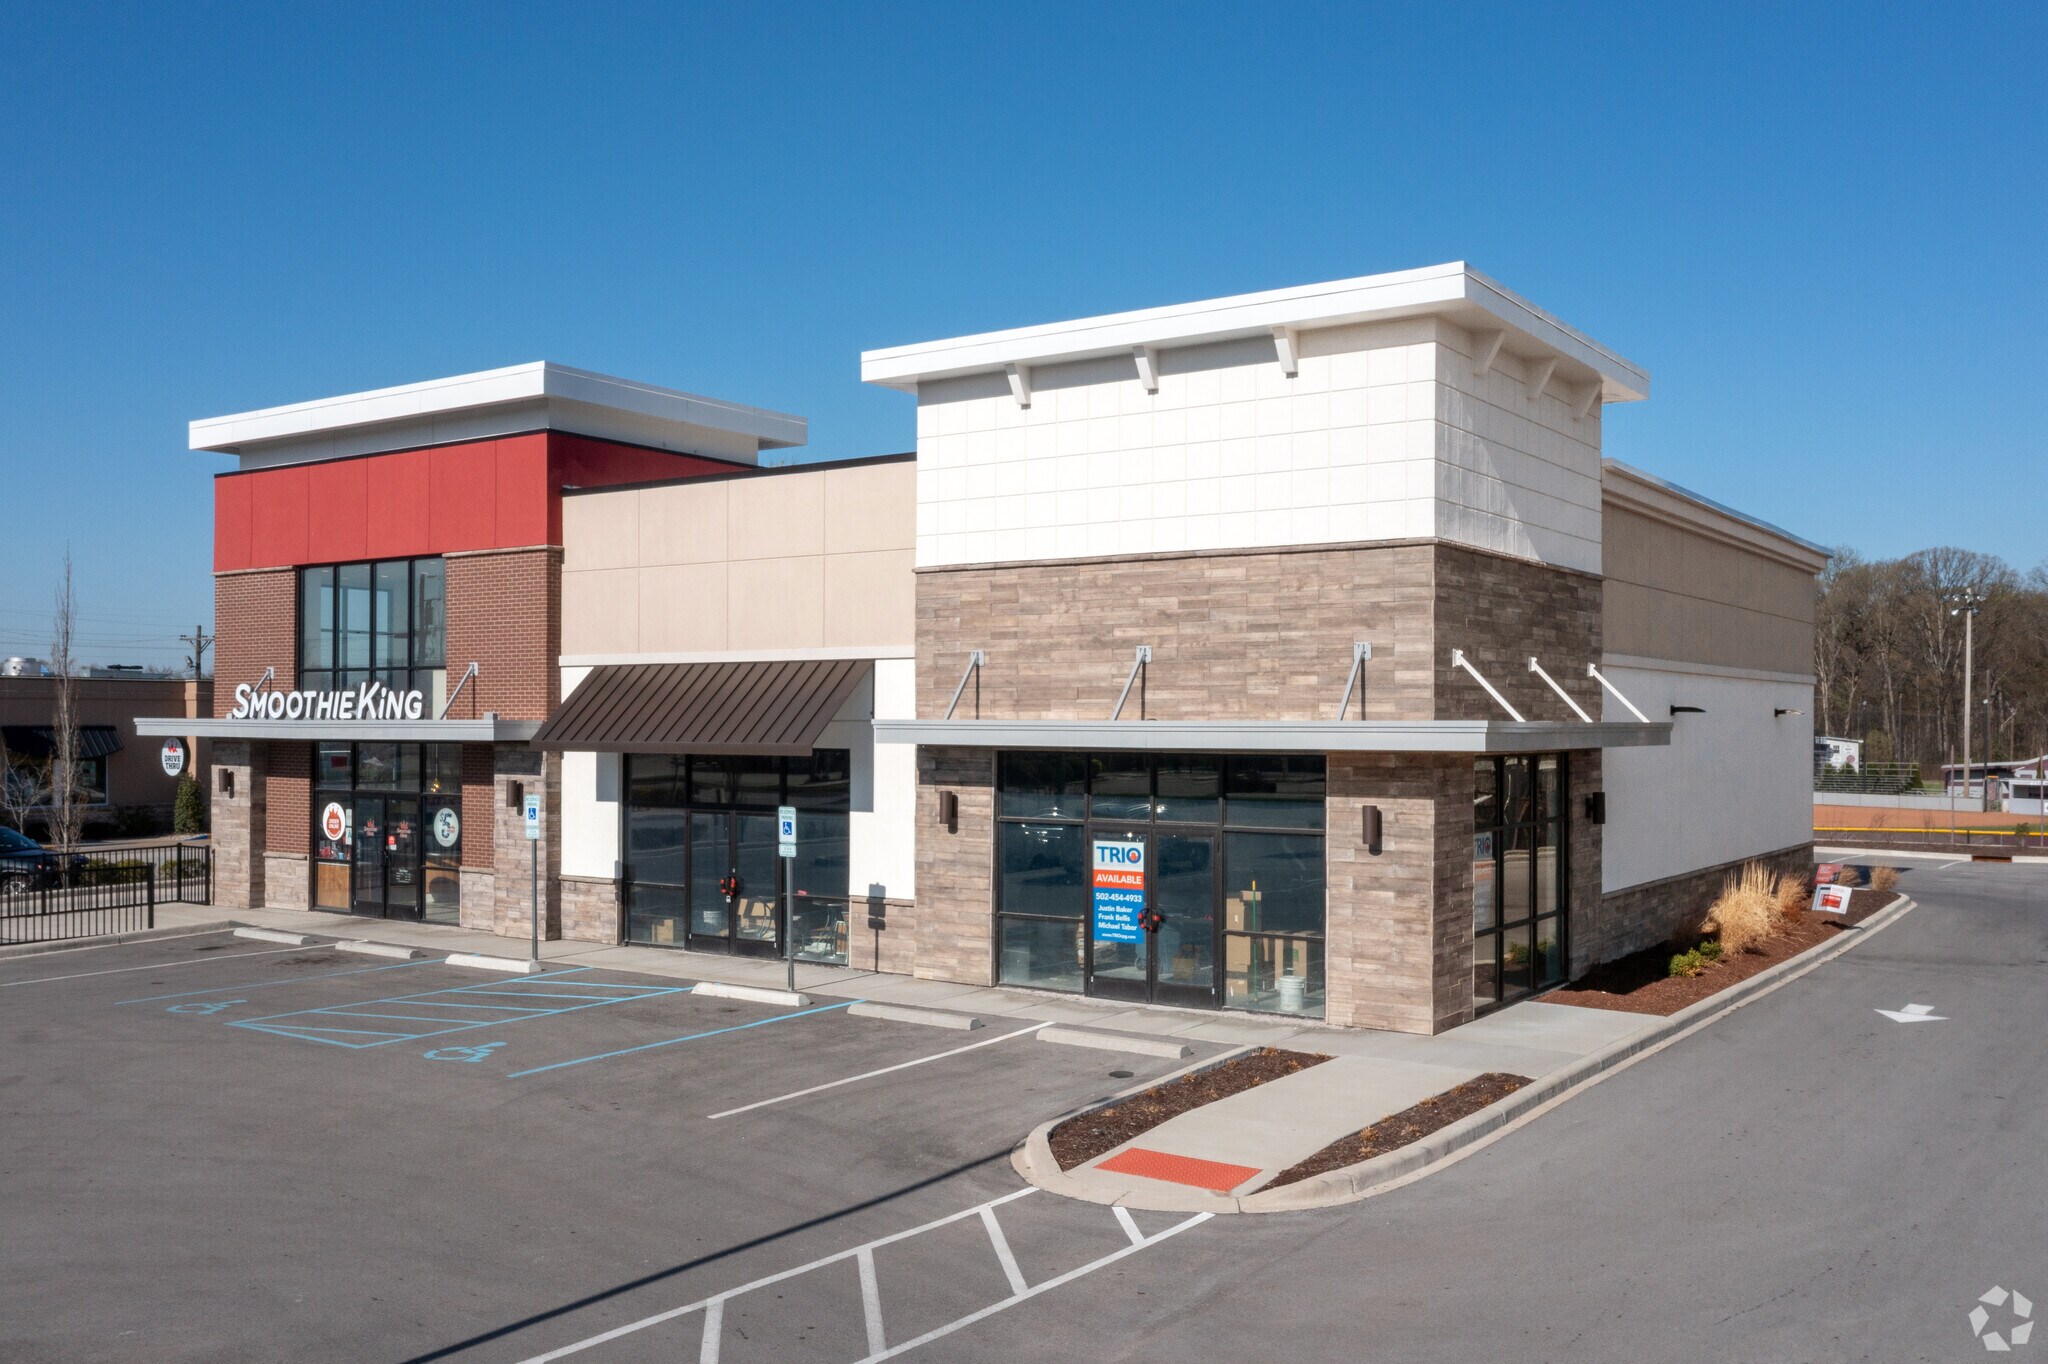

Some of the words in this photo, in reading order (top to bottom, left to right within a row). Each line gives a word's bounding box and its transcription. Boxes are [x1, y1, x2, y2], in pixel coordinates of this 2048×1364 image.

[1096, 846, 1142, 863] TRIO
[1096, 874, 1142, 884] AVAILABLE
[1096, 893, 1142, 902] 502-454-4933
[1098, 913, 1114, 921] Frank
[1098, 922, 1120, 930] Michael
[1121, 923, 1138, 931] Tabor
